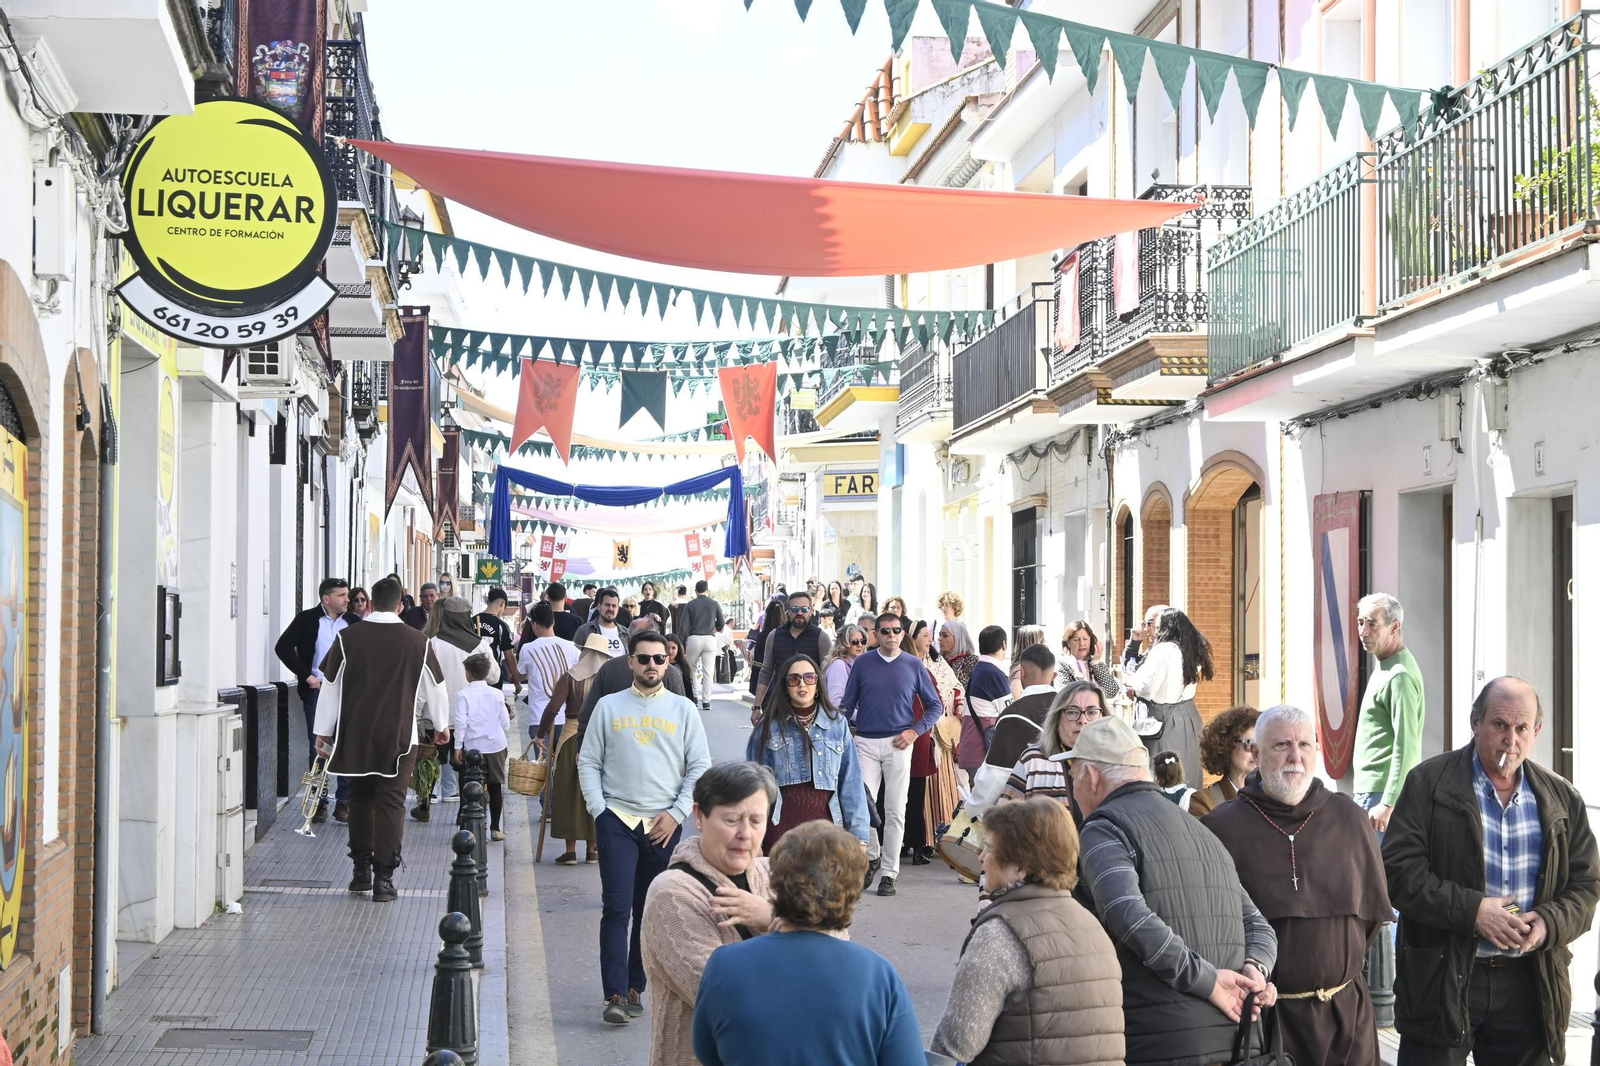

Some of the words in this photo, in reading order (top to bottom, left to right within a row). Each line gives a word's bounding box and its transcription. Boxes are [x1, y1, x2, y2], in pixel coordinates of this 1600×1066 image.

[161, 167, 294, 188] AUTOESCUELA
[137, 188, 316, 224] LIQUERAR
[167, 226, 207, 236] CENTRO
[209, 228, 222, 237] DE
[225, 229, 285, 240] FORMACIÓN
[152, 306, 191, 332] 661
[193, 322, 230, 339] 20
[237, 320, 267, 339] 59
[272, 306, 299, 329] 39
[613, 716, 677, 734] SILBON
